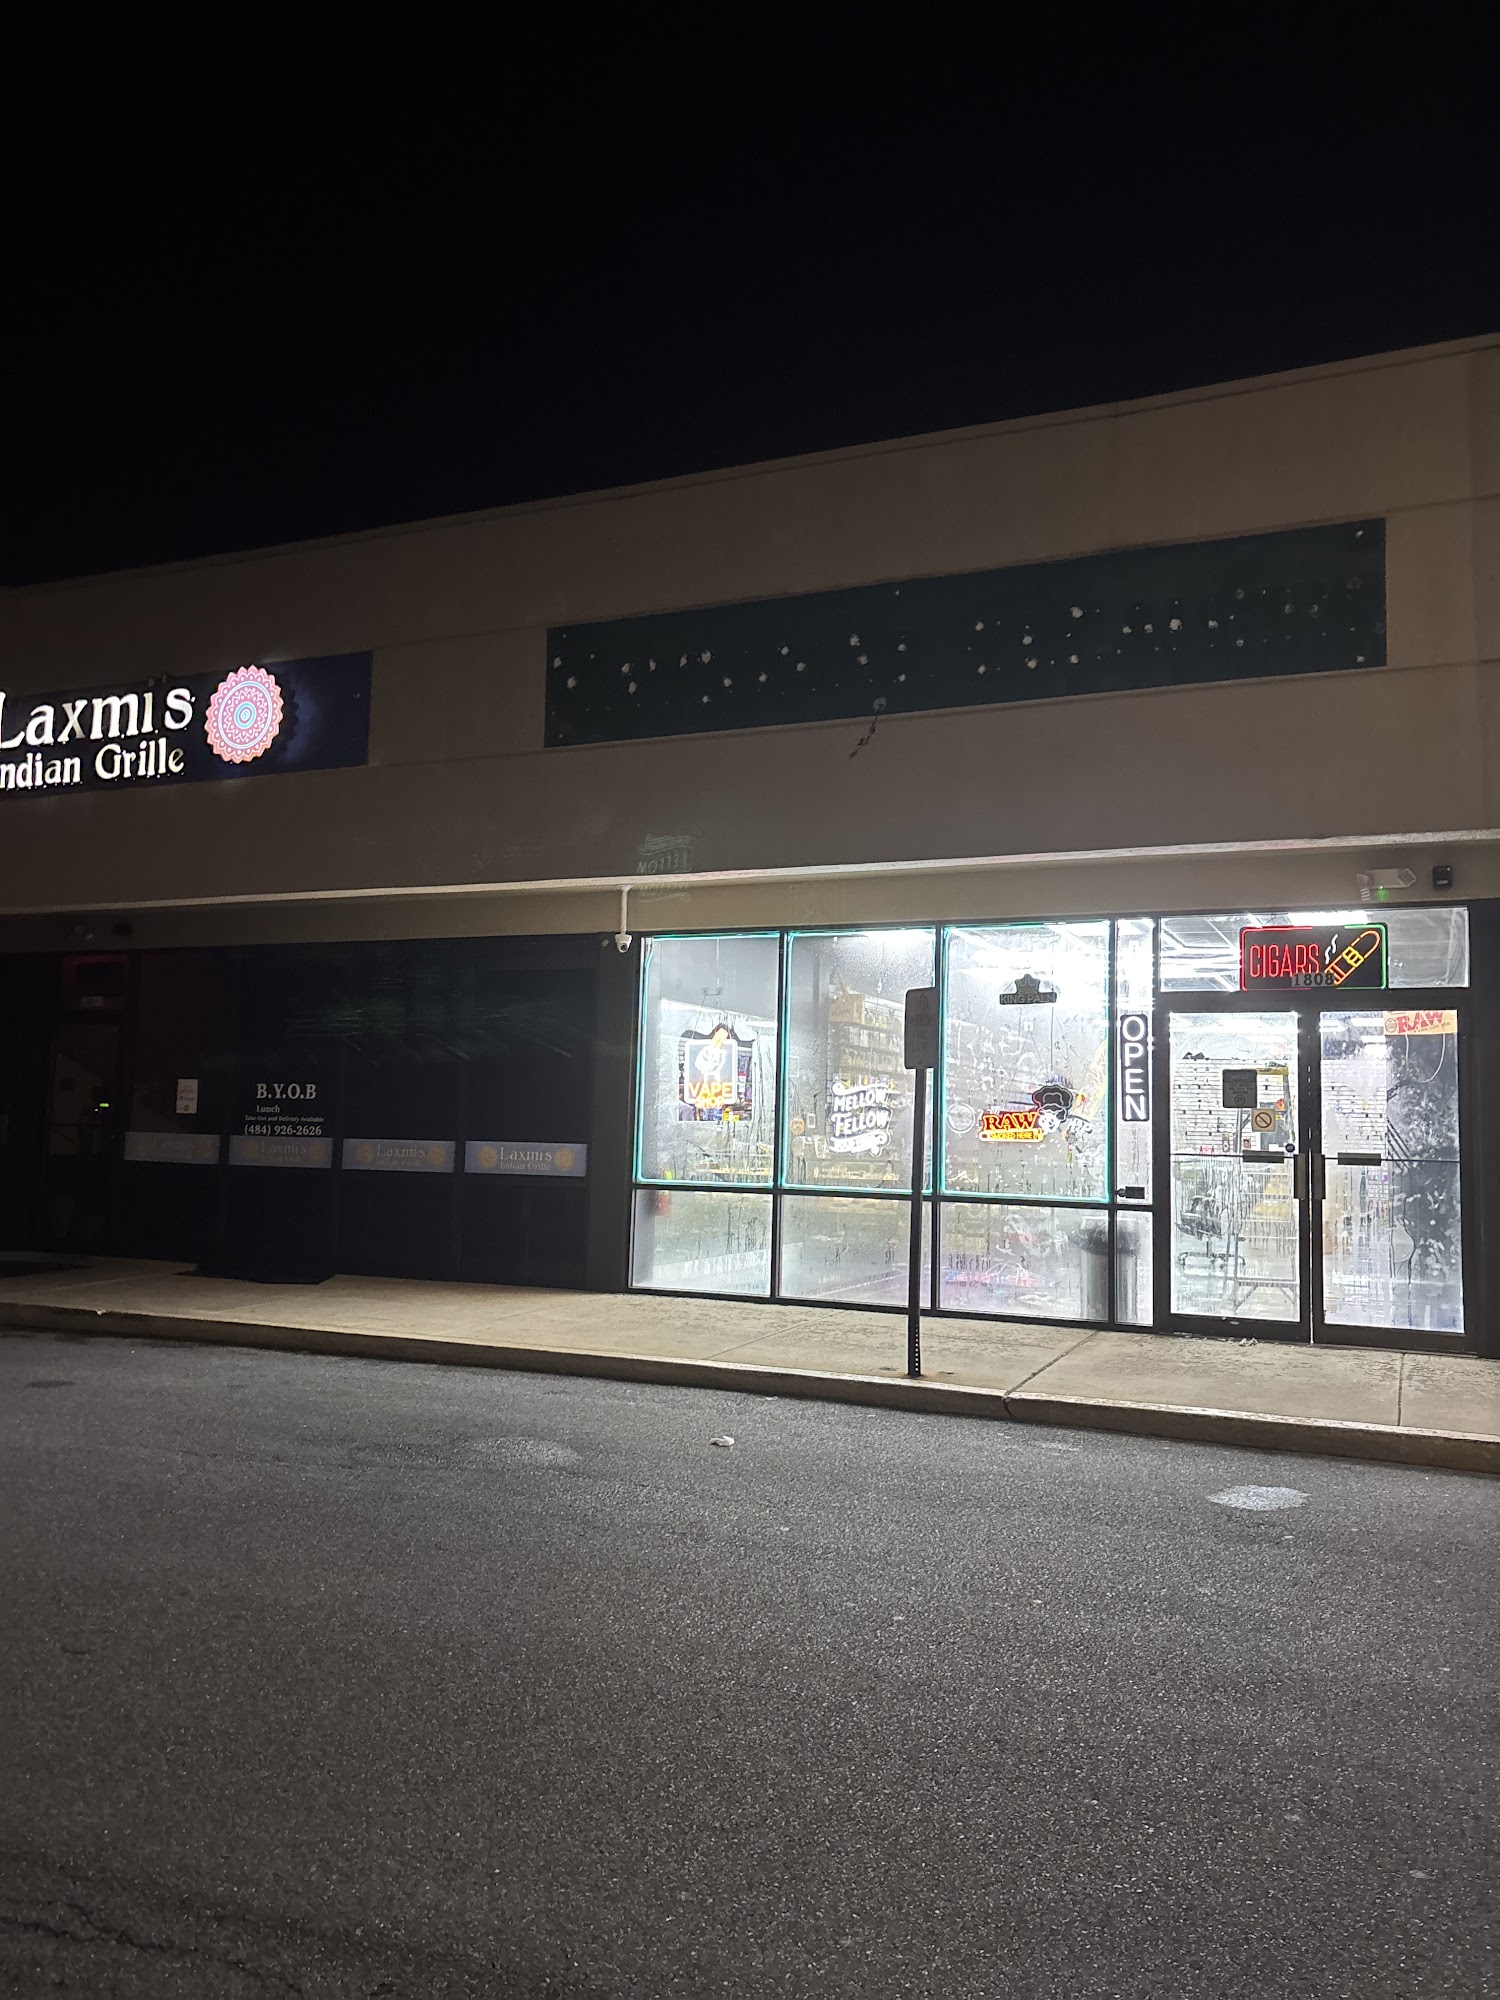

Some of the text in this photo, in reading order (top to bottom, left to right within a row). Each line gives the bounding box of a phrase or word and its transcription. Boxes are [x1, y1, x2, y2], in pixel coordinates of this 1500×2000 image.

[0, 738, 184, 789] ndian Grille
[1250, 943, 1320, 978] CIGARS
[1294, 973, 1335, 987] 1808
[1001, 993, 1056, 1003] KING PALM
[1122, 1016, 1146, 1121] OPEN
[256, 1083, 317, 1100] B.Y.O.B
[688, 1081, 733, 1098] VAPE
[695, 1094, 725, 1109] SHOP
[834, 1087, 887, 1112] MELLOW
[256, 1104, 281, 1113] Lunch
[244, 1124, 322, 1136] (484) 926-2626
[831, 1109, 889, 1137] FELLOW
[982, 1112, 1038, 1131] RAW
